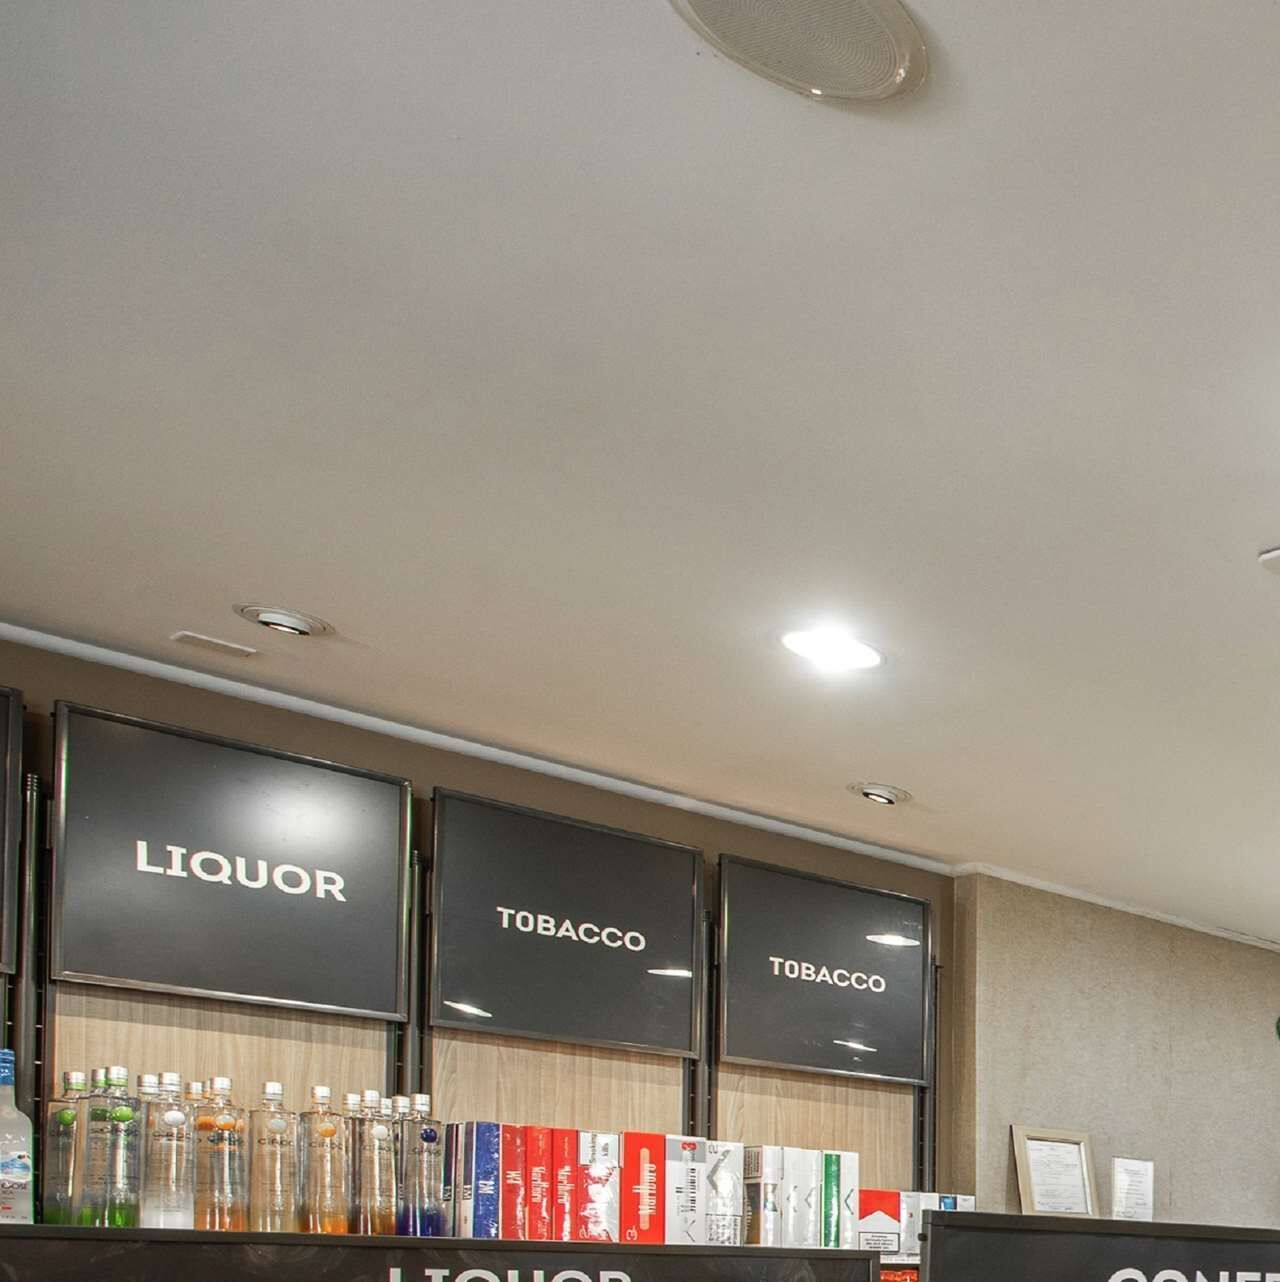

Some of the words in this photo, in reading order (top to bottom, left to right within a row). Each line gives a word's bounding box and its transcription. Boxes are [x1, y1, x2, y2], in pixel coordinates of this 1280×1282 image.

[136, 840, 347, 902] LIQUOR
[496, 906, 646, 952] TOBACCO
[769, 956, 886, 993] TOBACCO
[632, 1164, 656, 1215] Marlboro
